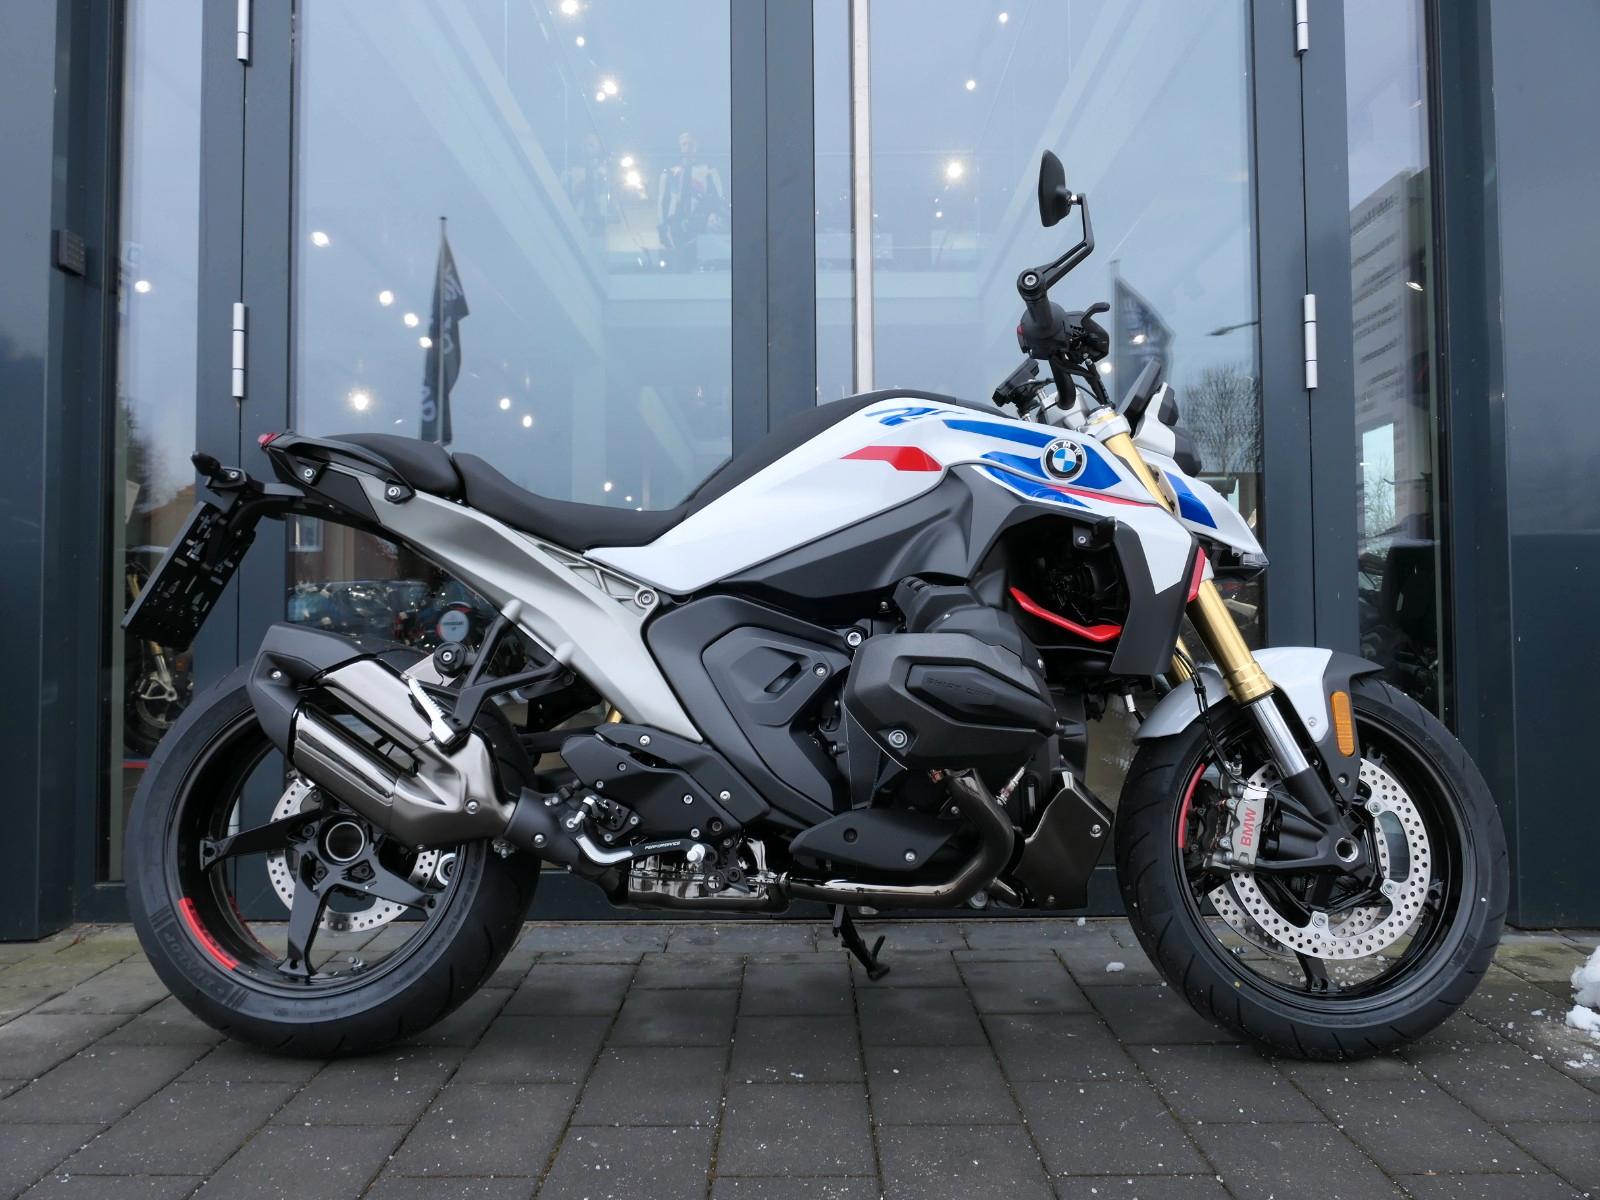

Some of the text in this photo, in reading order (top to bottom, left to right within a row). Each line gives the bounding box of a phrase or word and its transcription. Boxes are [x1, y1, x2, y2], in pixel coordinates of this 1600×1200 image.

[1050, 441, 1082, 456] BMW
[1240, 807, 1257, 848] BMW
[162, 930, 217, 990] DUNLOP
